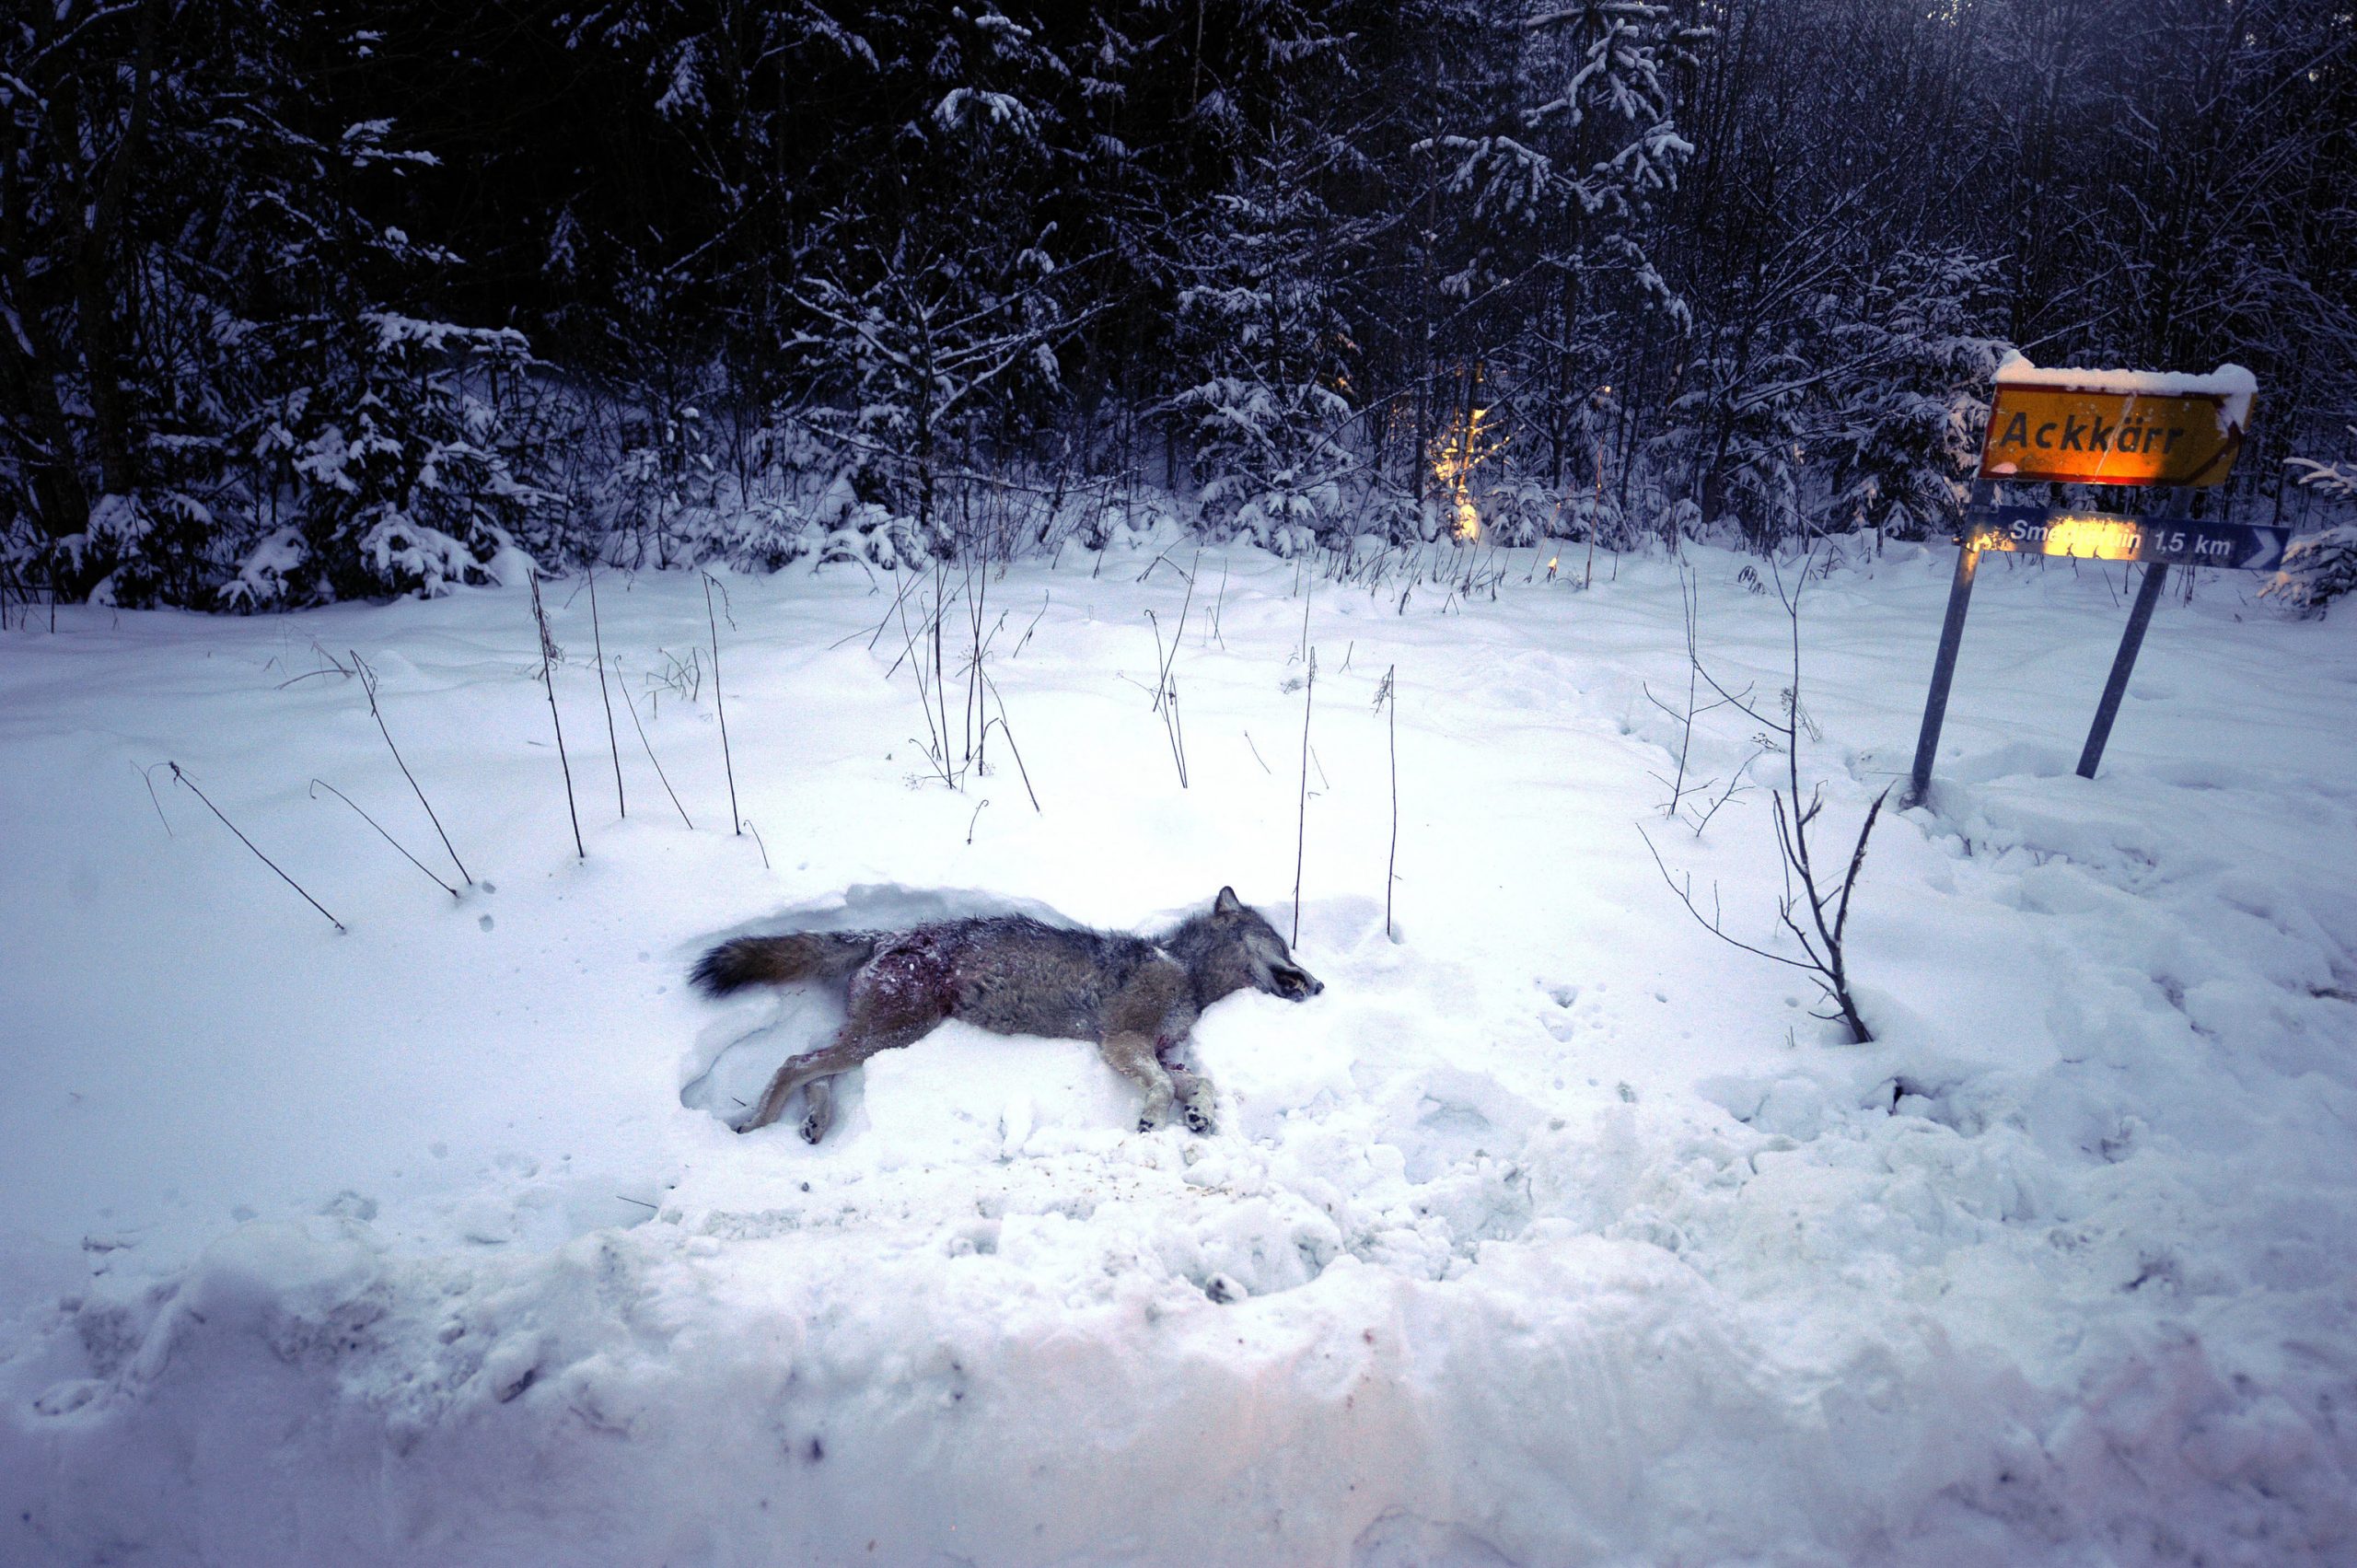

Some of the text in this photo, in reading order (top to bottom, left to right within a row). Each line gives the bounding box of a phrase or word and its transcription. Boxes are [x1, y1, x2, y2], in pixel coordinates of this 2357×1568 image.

[1999, 412, 2185, 454] Ackkärr
[2154, 530, 2186, 553] 1,5
[2195, 534, 2231, 555] km
